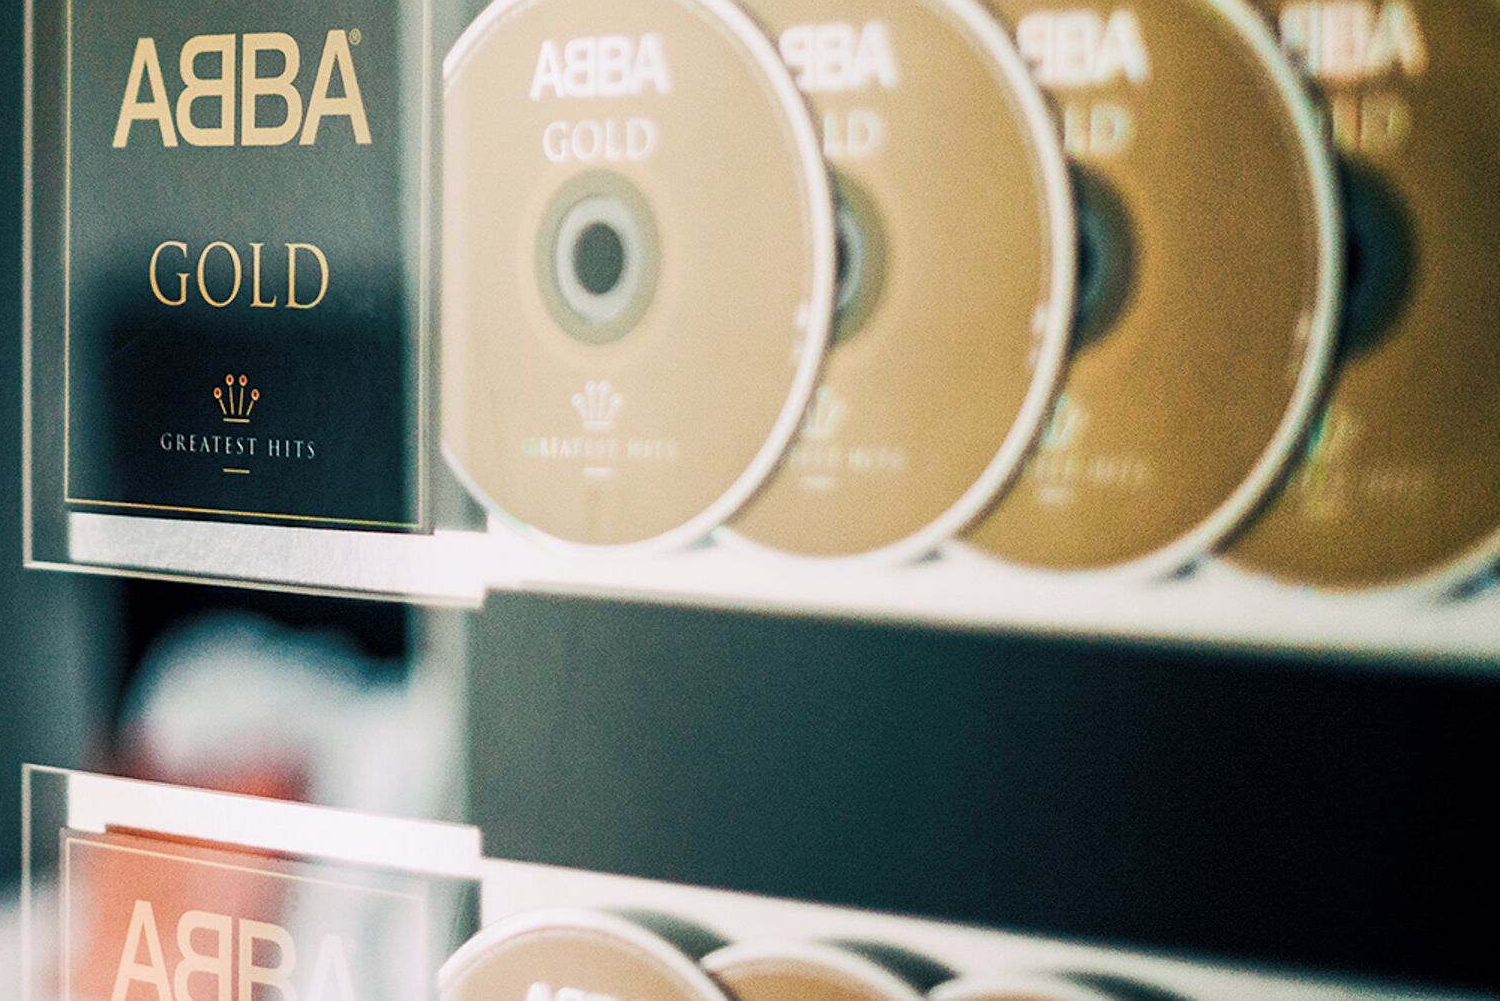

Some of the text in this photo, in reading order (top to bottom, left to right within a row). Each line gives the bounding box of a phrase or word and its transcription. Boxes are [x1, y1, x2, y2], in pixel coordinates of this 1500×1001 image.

[529, 31, 672, 100] ABBA
[779, 18, 899, 90] BBA
[1016, 8, 1151, 86] BBA
[542, 117, 656, 163] GOLD
[149, 240, 330, 310] GOLD
[160, 432, 316, 460] GREATEST HITS
